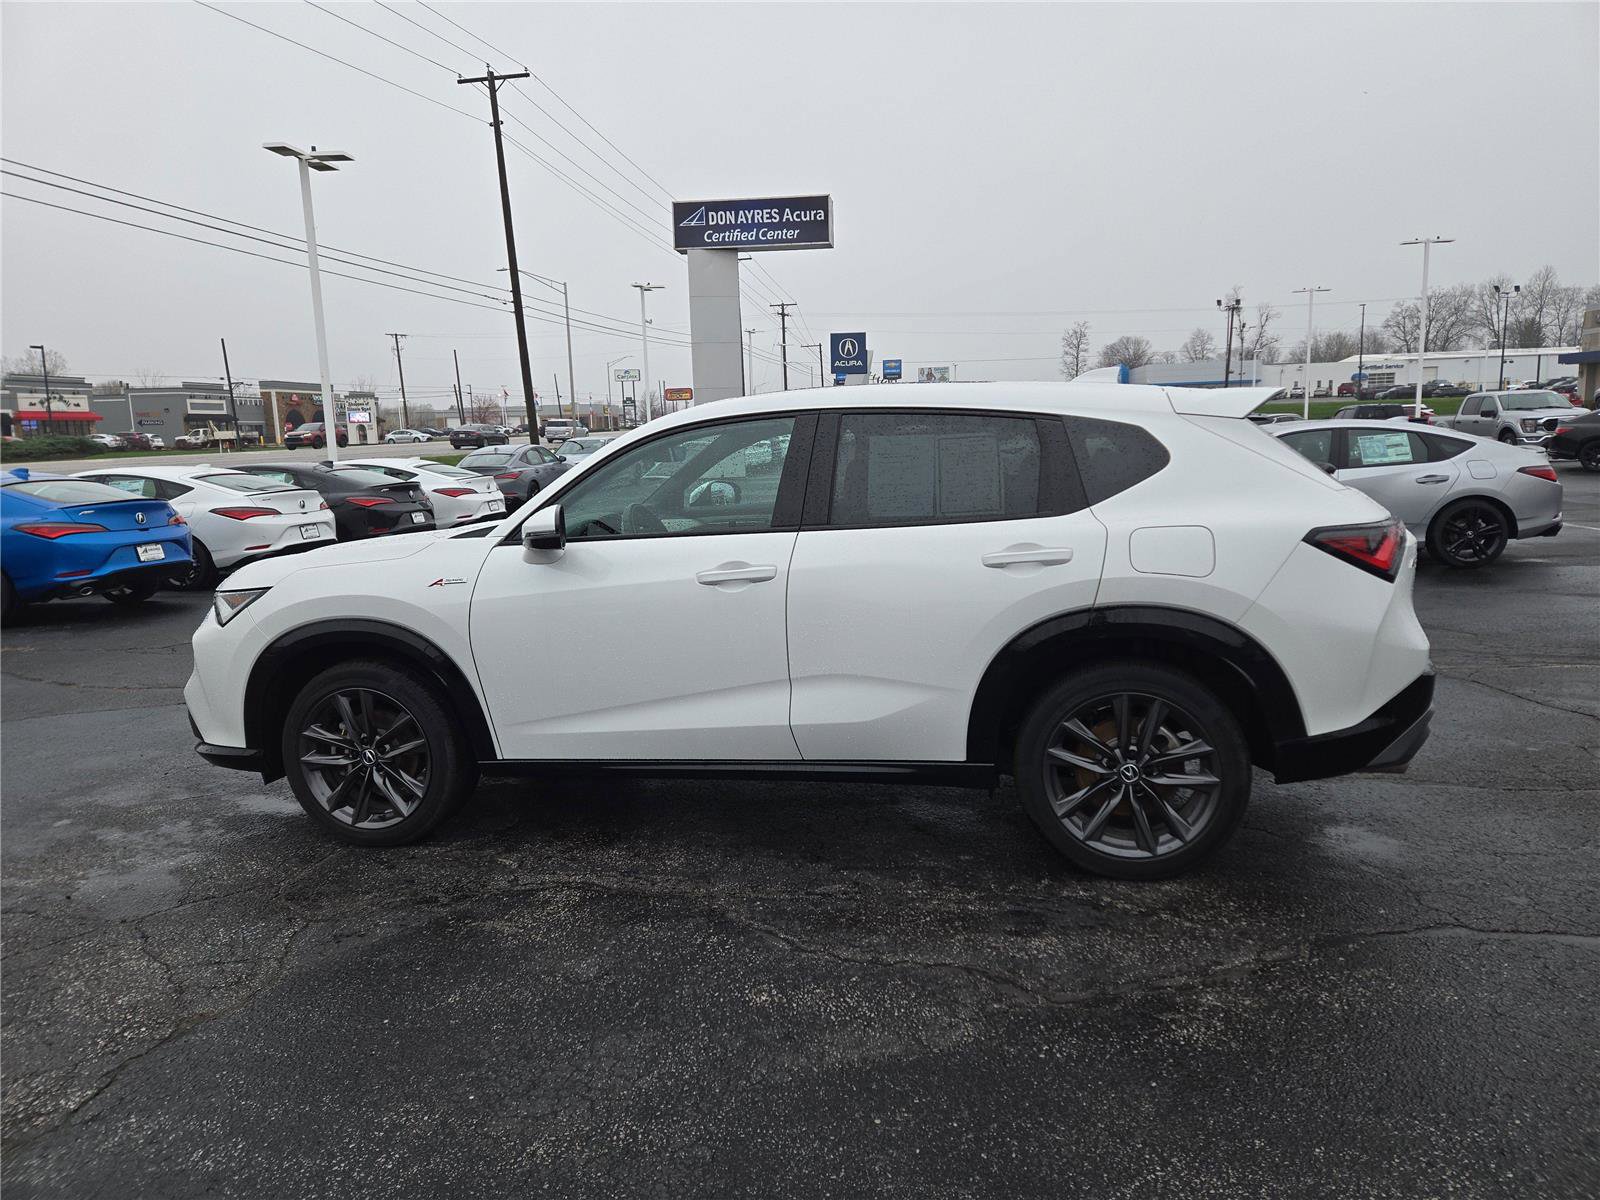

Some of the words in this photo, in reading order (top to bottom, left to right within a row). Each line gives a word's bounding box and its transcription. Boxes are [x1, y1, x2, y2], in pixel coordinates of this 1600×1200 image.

[708, 210, 735, 225] DON
[737, 208, 779, 224] AYRES
[783, 208, 825, 222] Acura
[704, 228, 757, 242] Certified
[758, 228, 800, 240] Center
